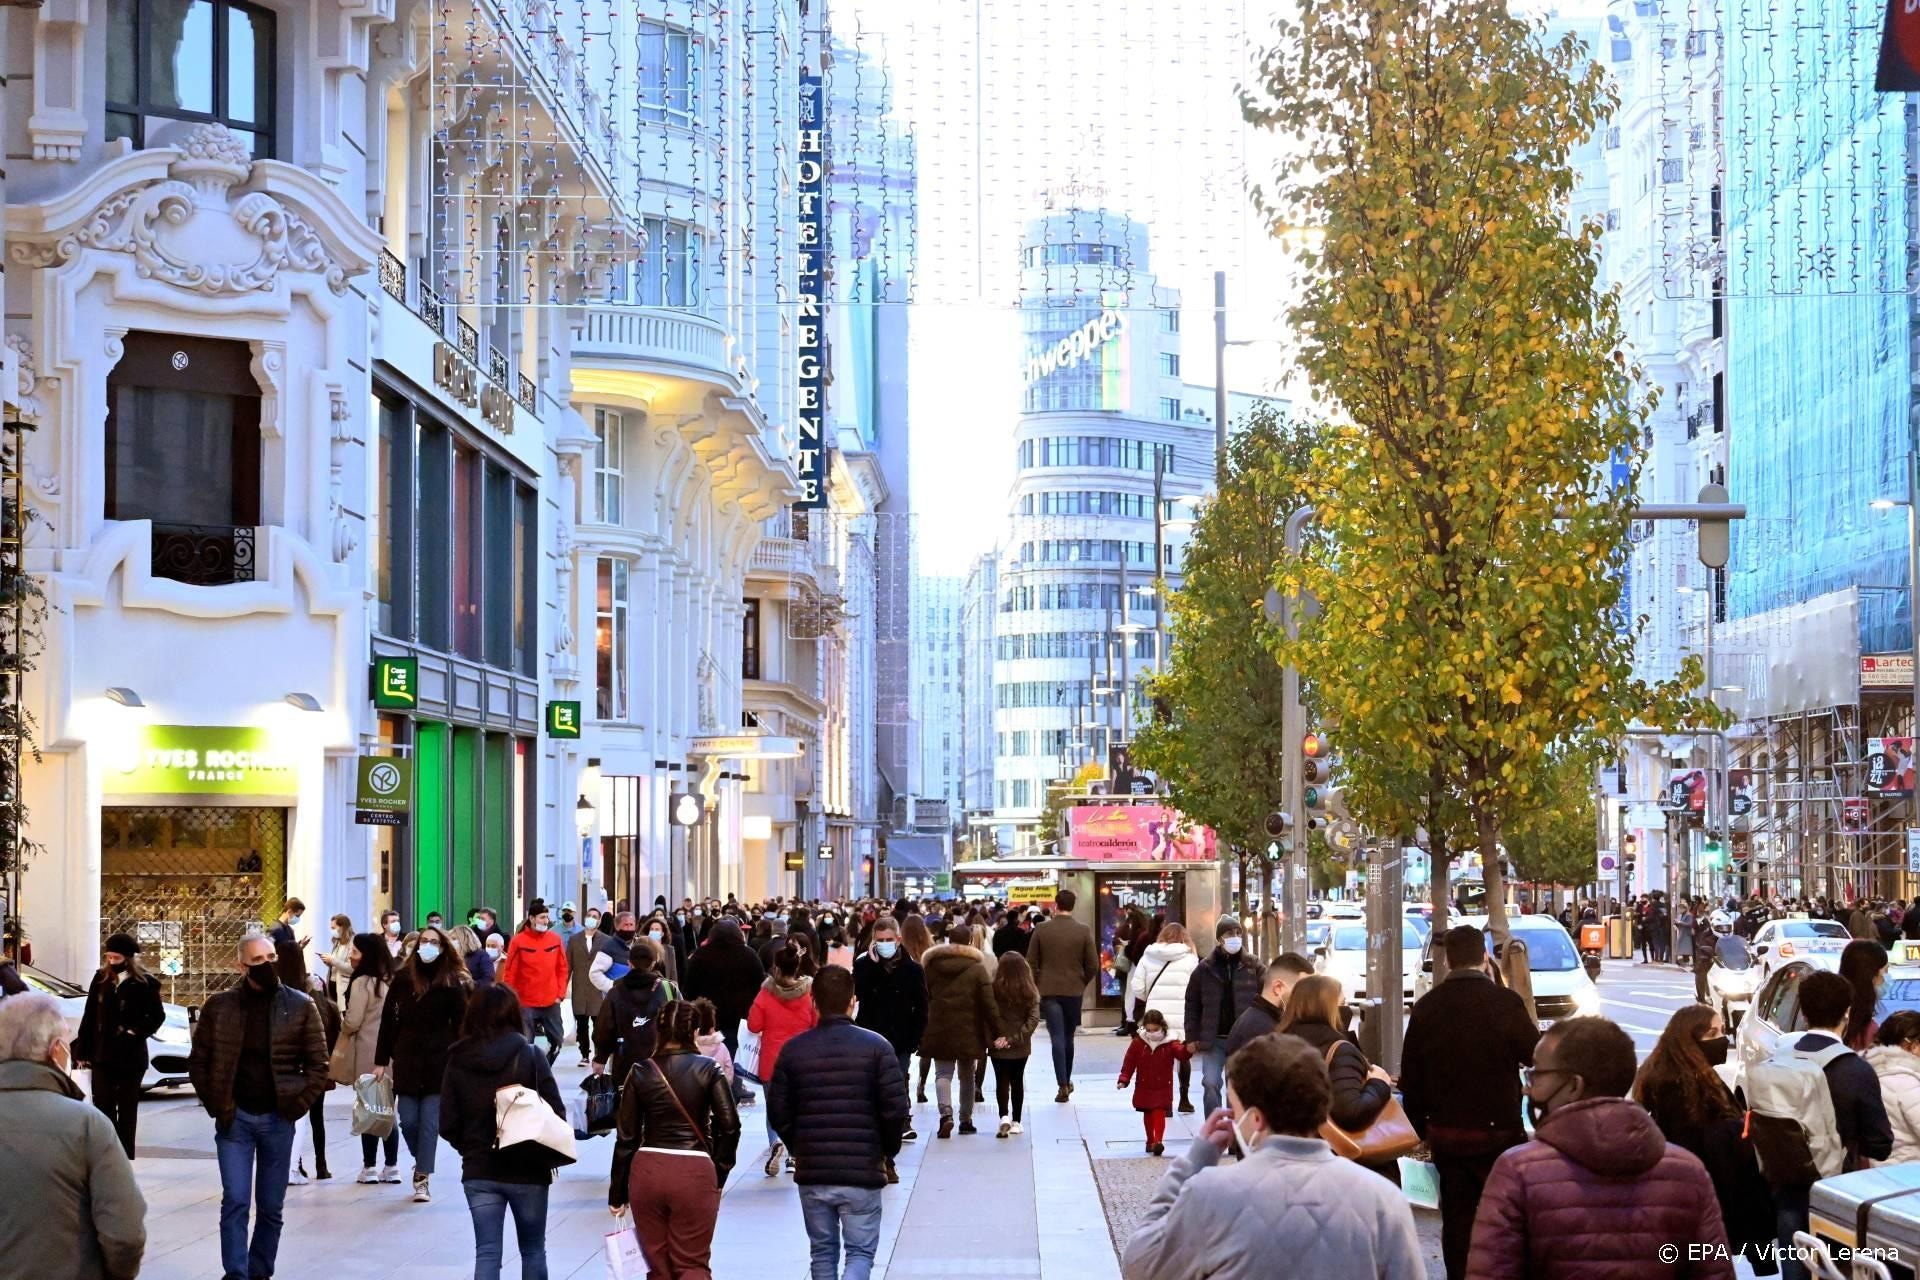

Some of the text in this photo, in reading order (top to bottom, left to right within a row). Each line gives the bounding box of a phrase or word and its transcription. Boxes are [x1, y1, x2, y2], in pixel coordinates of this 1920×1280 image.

[798, 129, 822, 502] HOTEL REGENTE
[1112, 889, 1167, 909] Trolls 2
